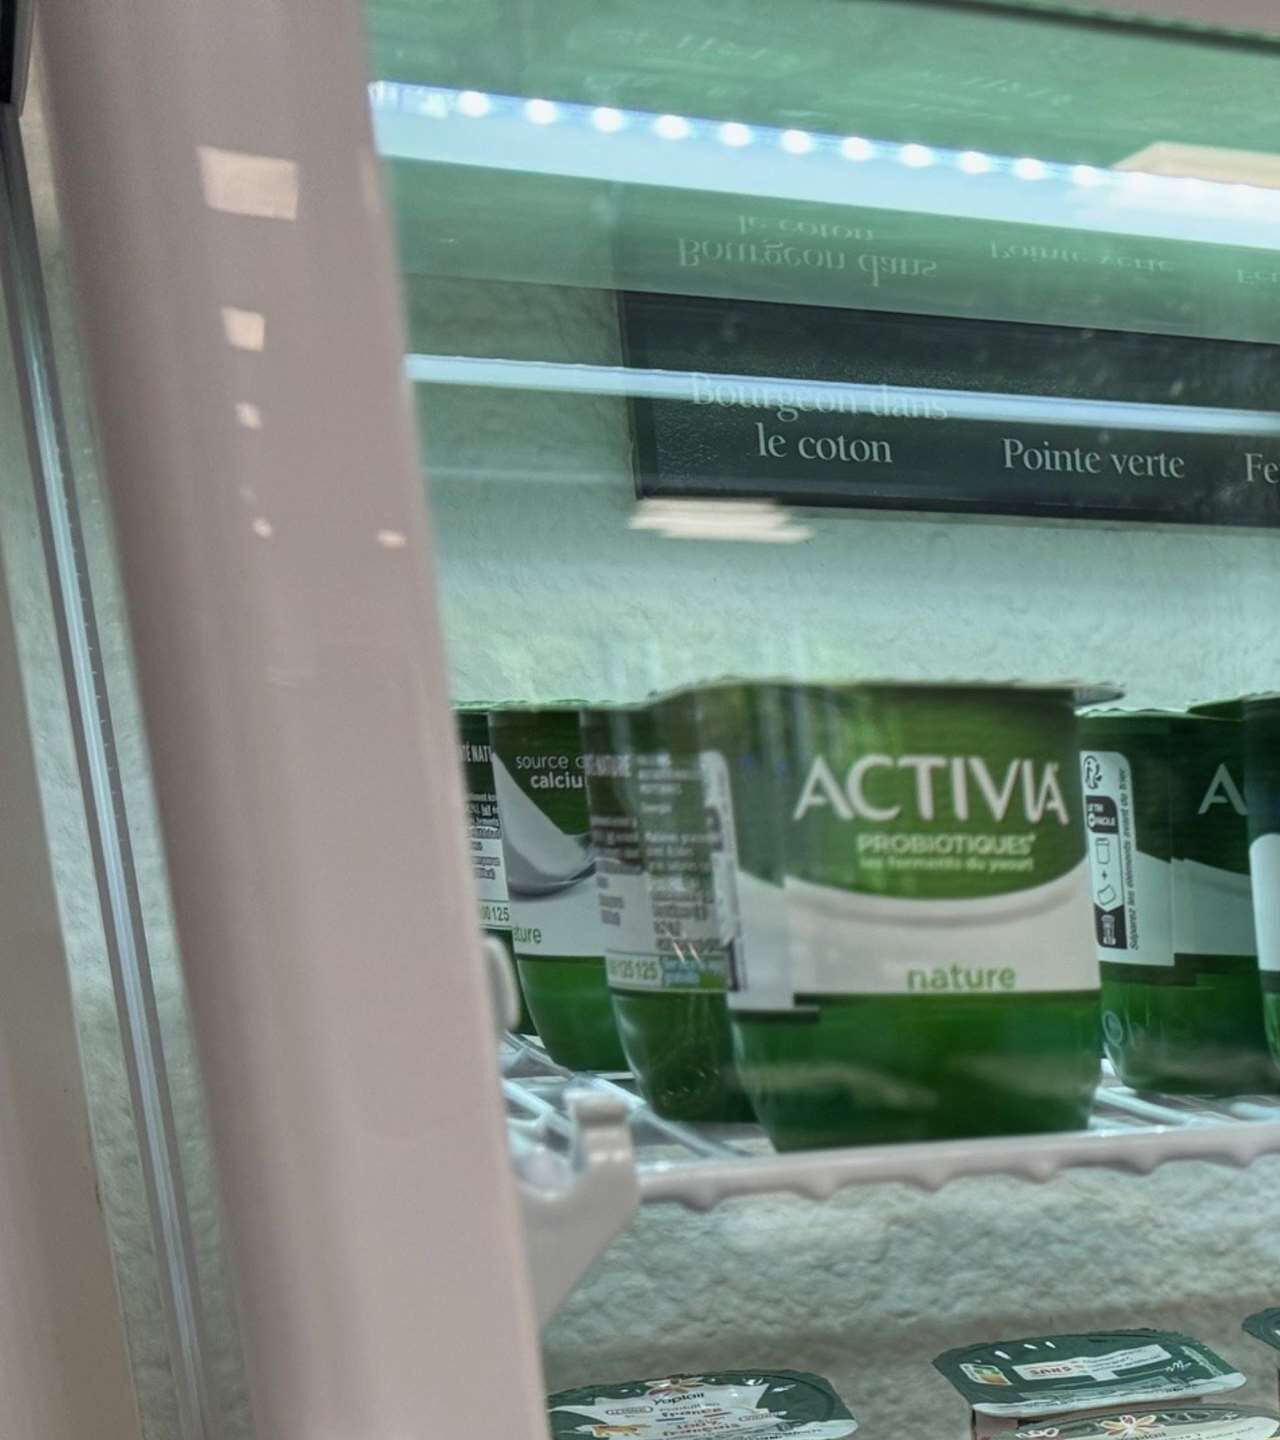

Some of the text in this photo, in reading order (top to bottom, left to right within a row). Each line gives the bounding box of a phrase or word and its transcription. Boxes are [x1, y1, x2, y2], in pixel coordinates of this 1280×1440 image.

[692, 371, 948, 423] Bourgeon dans
[755, 421, 894, 464] le coton
[1001, 437, 1186, 480] Pointe verte
[515, 754, 569, 770] source
[529, 771, 586, 790] calciu
[793, 752, 1069, 826] ACTIVIA
[905, 961, 1017, 991] nature
